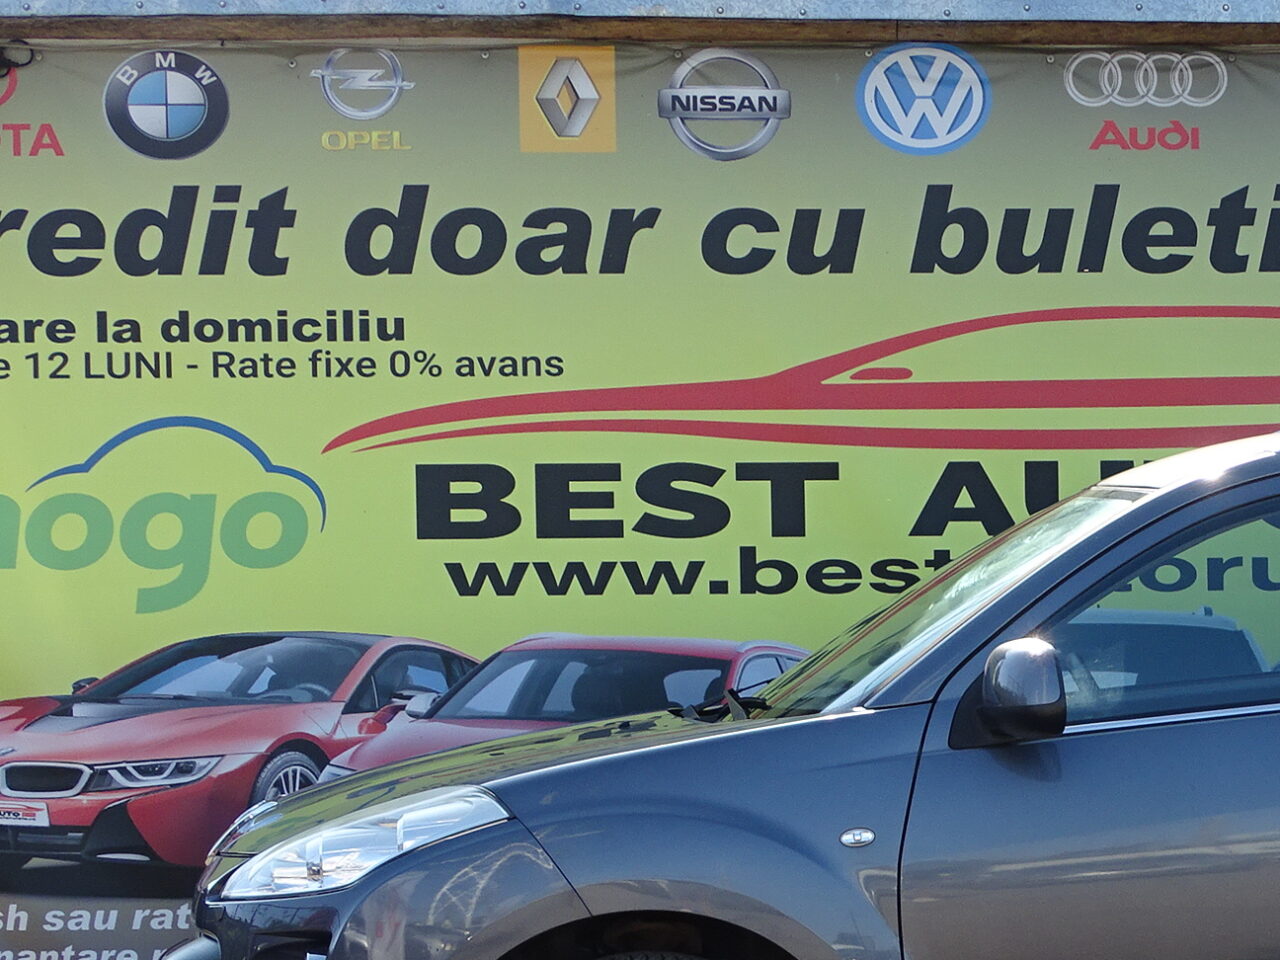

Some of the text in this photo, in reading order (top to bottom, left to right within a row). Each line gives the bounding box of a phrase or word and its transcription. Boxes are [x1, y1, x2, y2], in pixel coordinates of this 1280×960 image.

[116, 52, 218, 86] BMW
[671, 93, 779, 114] NISSAN
[0, 123, 65, 157] TA
[320, 130, 412, 151] OPEL
[1089, 120, 1200, 151] Audi
[344, 184, 661, 276] doar
[701, 208, 865, 275] cu
[0, 310, 405, 343] are la domiciliu
[25, 351, 71, 379] 12
[84, 351, 173, 379] LUNI
[212, 351, 297, 378] Rate
[308, 350, 377, 378] fixe
[389, 350, 442, 378] 0%
[454, 353, 564, 378] avans
[415, 461, 840, 540] BEST
[0, 903, 192, 931] h sau rat
